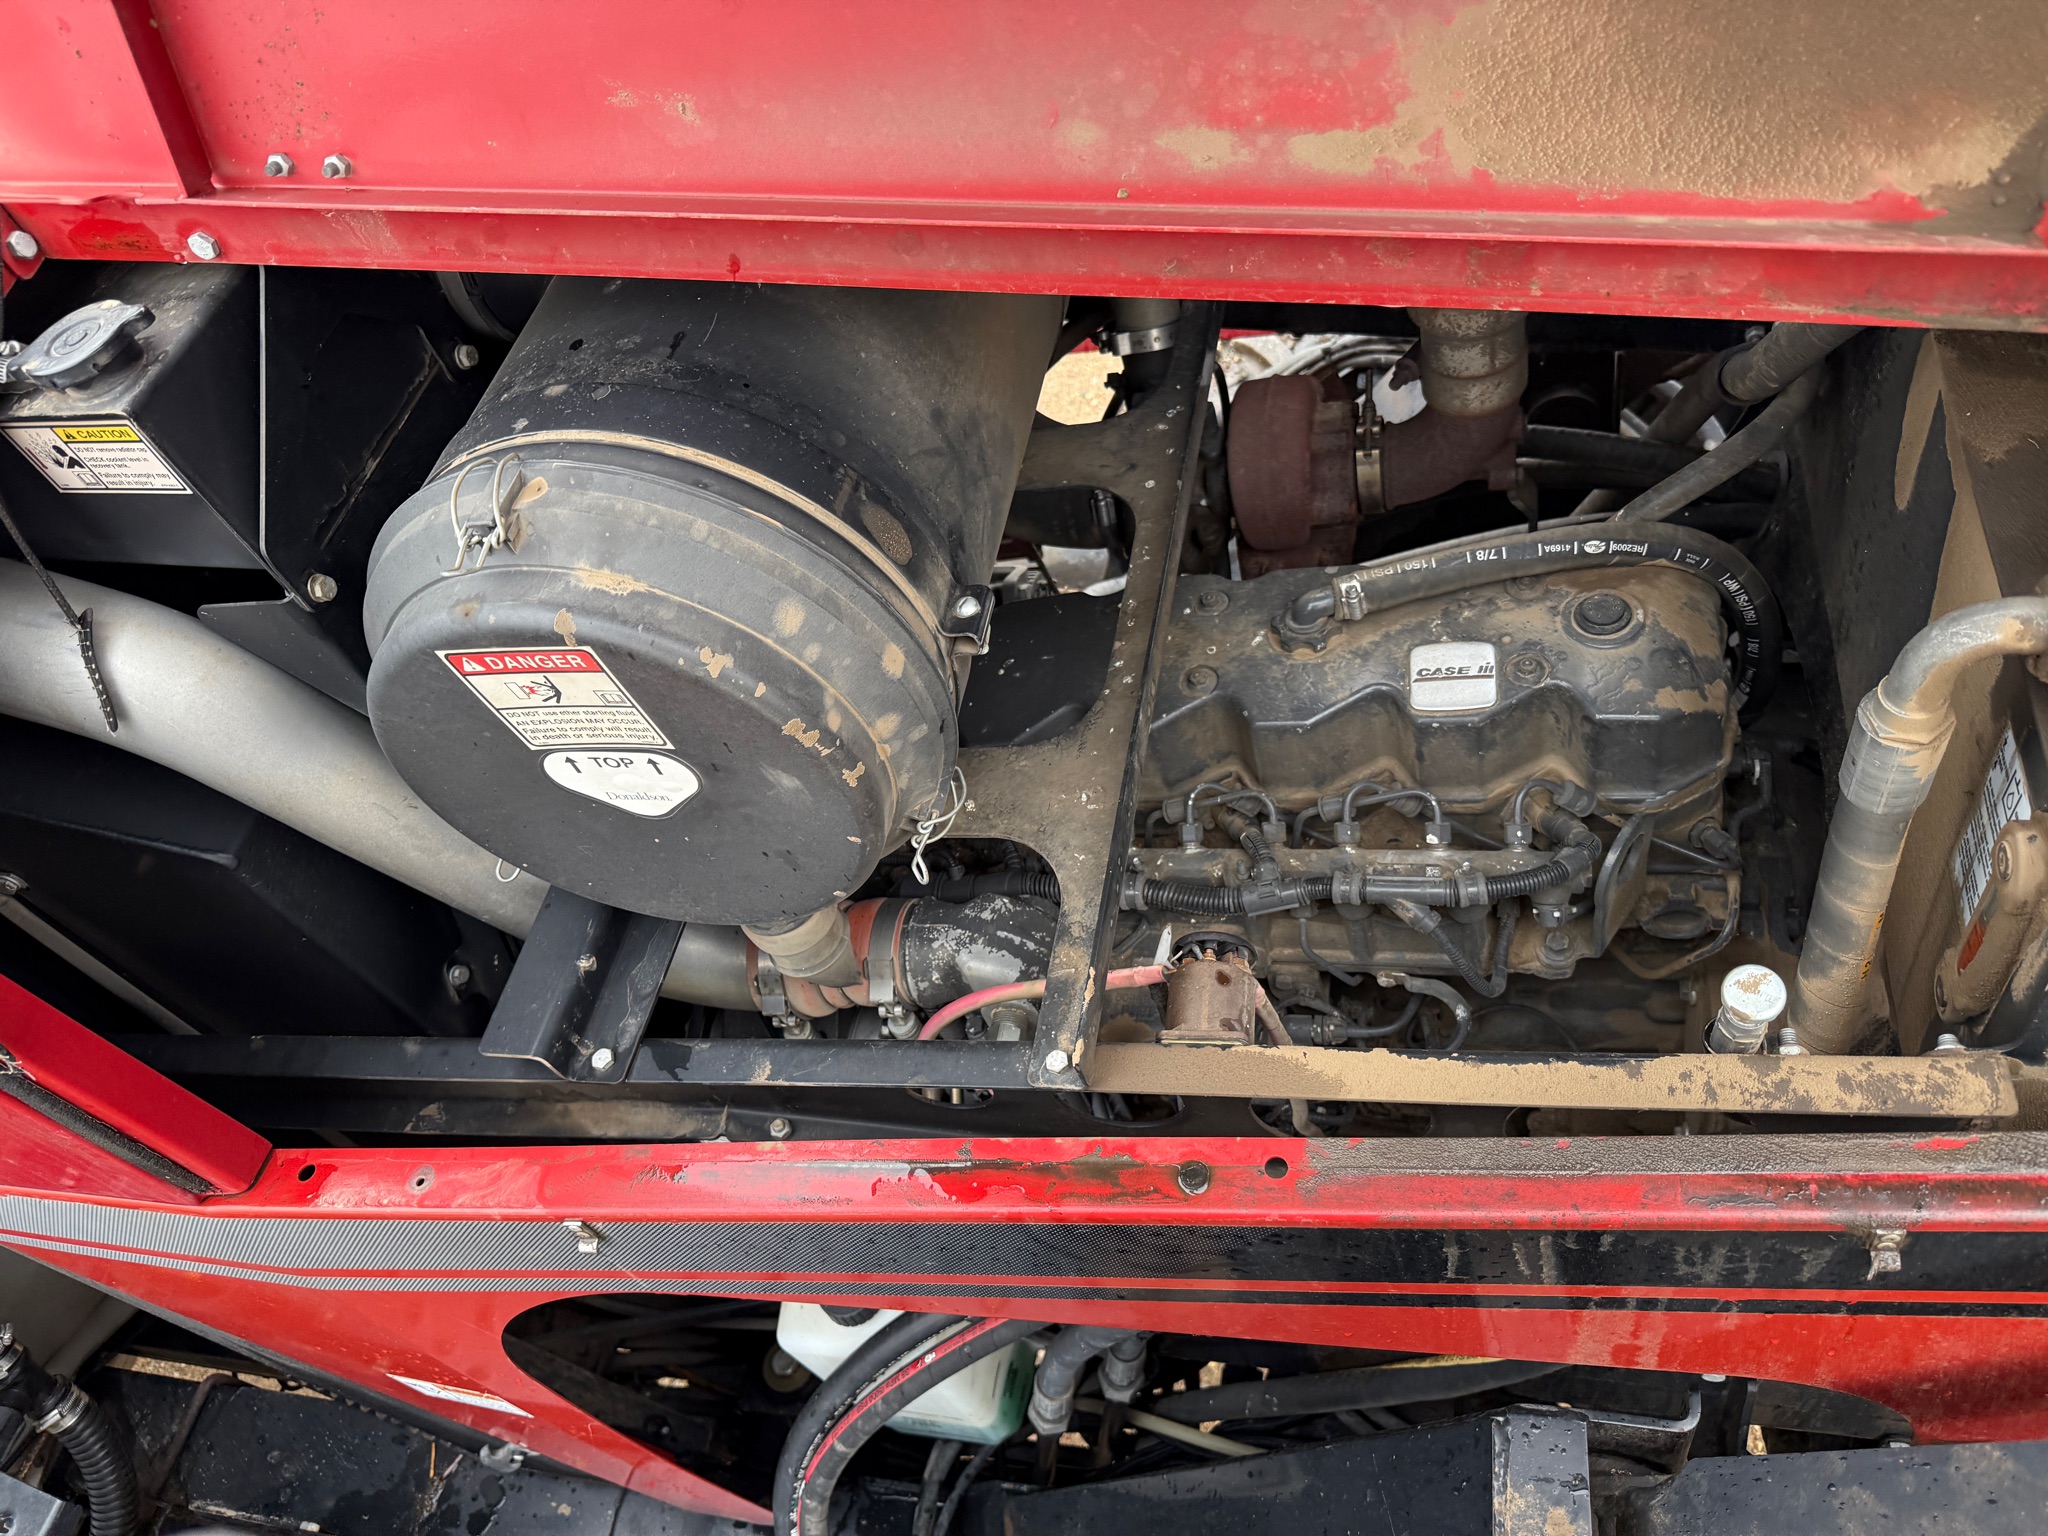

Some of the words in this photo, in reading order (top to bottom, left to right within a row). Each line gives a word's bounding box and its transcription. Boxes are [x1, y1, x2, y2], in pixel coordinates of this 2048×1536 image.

[76, 429, 132, 439] CAUTION
[1543, 544, 1571, 553] 4169A
[1612, 542, 1644, 553] RE2009
[1475, 549, 1498, 561] 7/8
[1404, 559, 1429, 571] 150
[1722, 578, 1741, 593] WP
[1734, 593, 1752, 608] PSI
[483, 654, 587, 670] DANGER
[1416, 665, 1472, 677] CASE
[520, 710, 541, 718] NOT
[529, 718, 585, 726] EXPLOSION
[568, 725, 604, 733] comply
[624, 732, 659, 741] injury.
[587, 757, 634, 769] TOP
